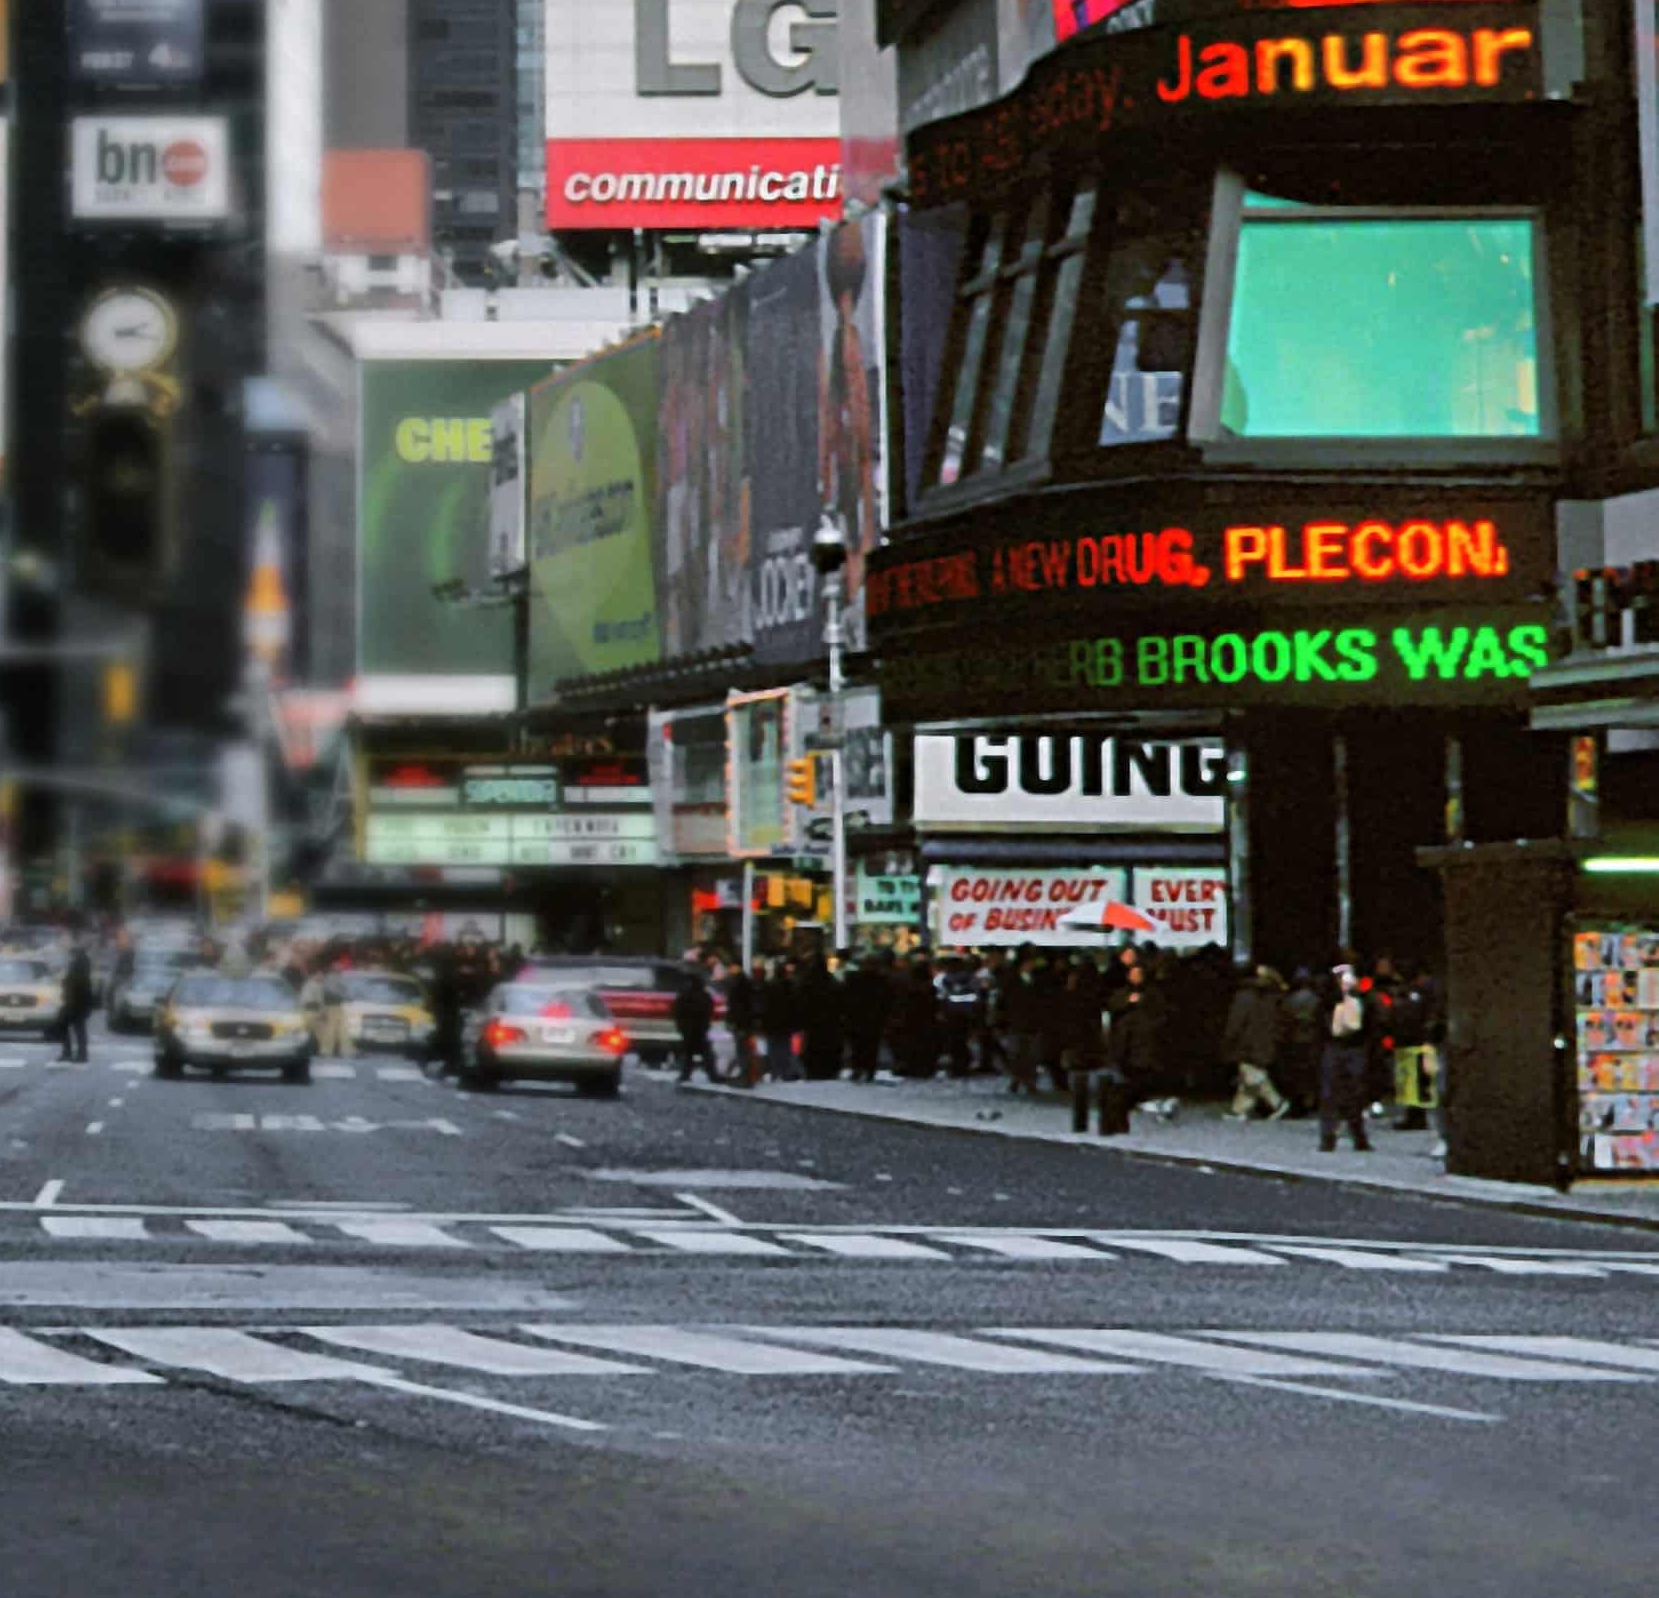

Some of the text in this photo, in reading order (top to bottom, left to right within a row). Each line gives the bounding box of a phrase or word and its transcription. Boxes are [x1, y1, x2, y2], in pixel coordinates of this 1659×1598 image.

[1157, 27, 1531, 102] Januar
[96, 129, 156, 184] bn
[396, 417, 493, 464] CHE
[1137, 628, 1378, 686] BROOKS
[1392, 624, 1549, 681] WAS
[950, 878, 1109, 903] GOING OUT
